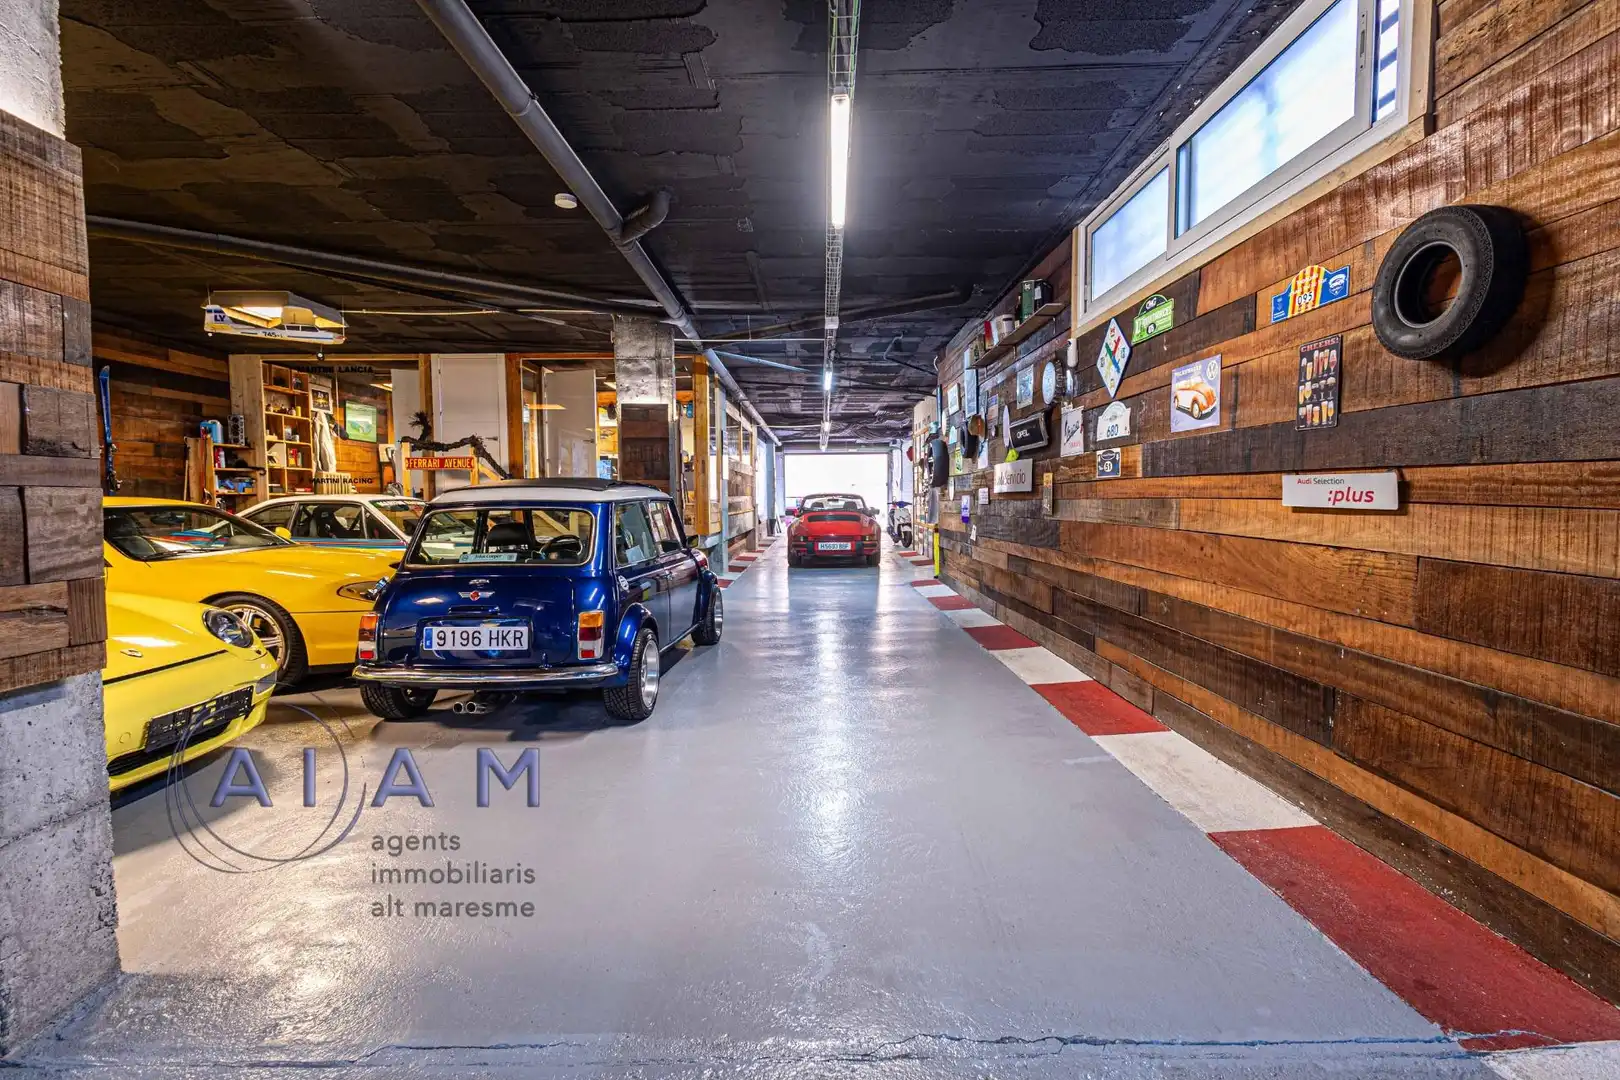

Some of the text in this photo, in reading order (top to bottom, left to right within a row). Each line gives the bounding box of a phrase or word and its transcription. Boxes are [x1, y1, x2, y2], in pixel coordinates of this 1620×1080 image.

[1297, 292, 1312, 305] 095
[214, 314, 226, 322] LY
[1300, 337, 1339, 353] CHEERS!
[338, 366, 374, 374] LANCIA
[1016, 429, 1030, 439] OPEL
[1106, 424, 1119, 437] 680
[409, 458, 471, 468] FERRARI AVENUE
[1313, 477, 1345, 485] Selection
[436, 630, 482, 647] 9196
[489, 630, 524, 647] HKR
